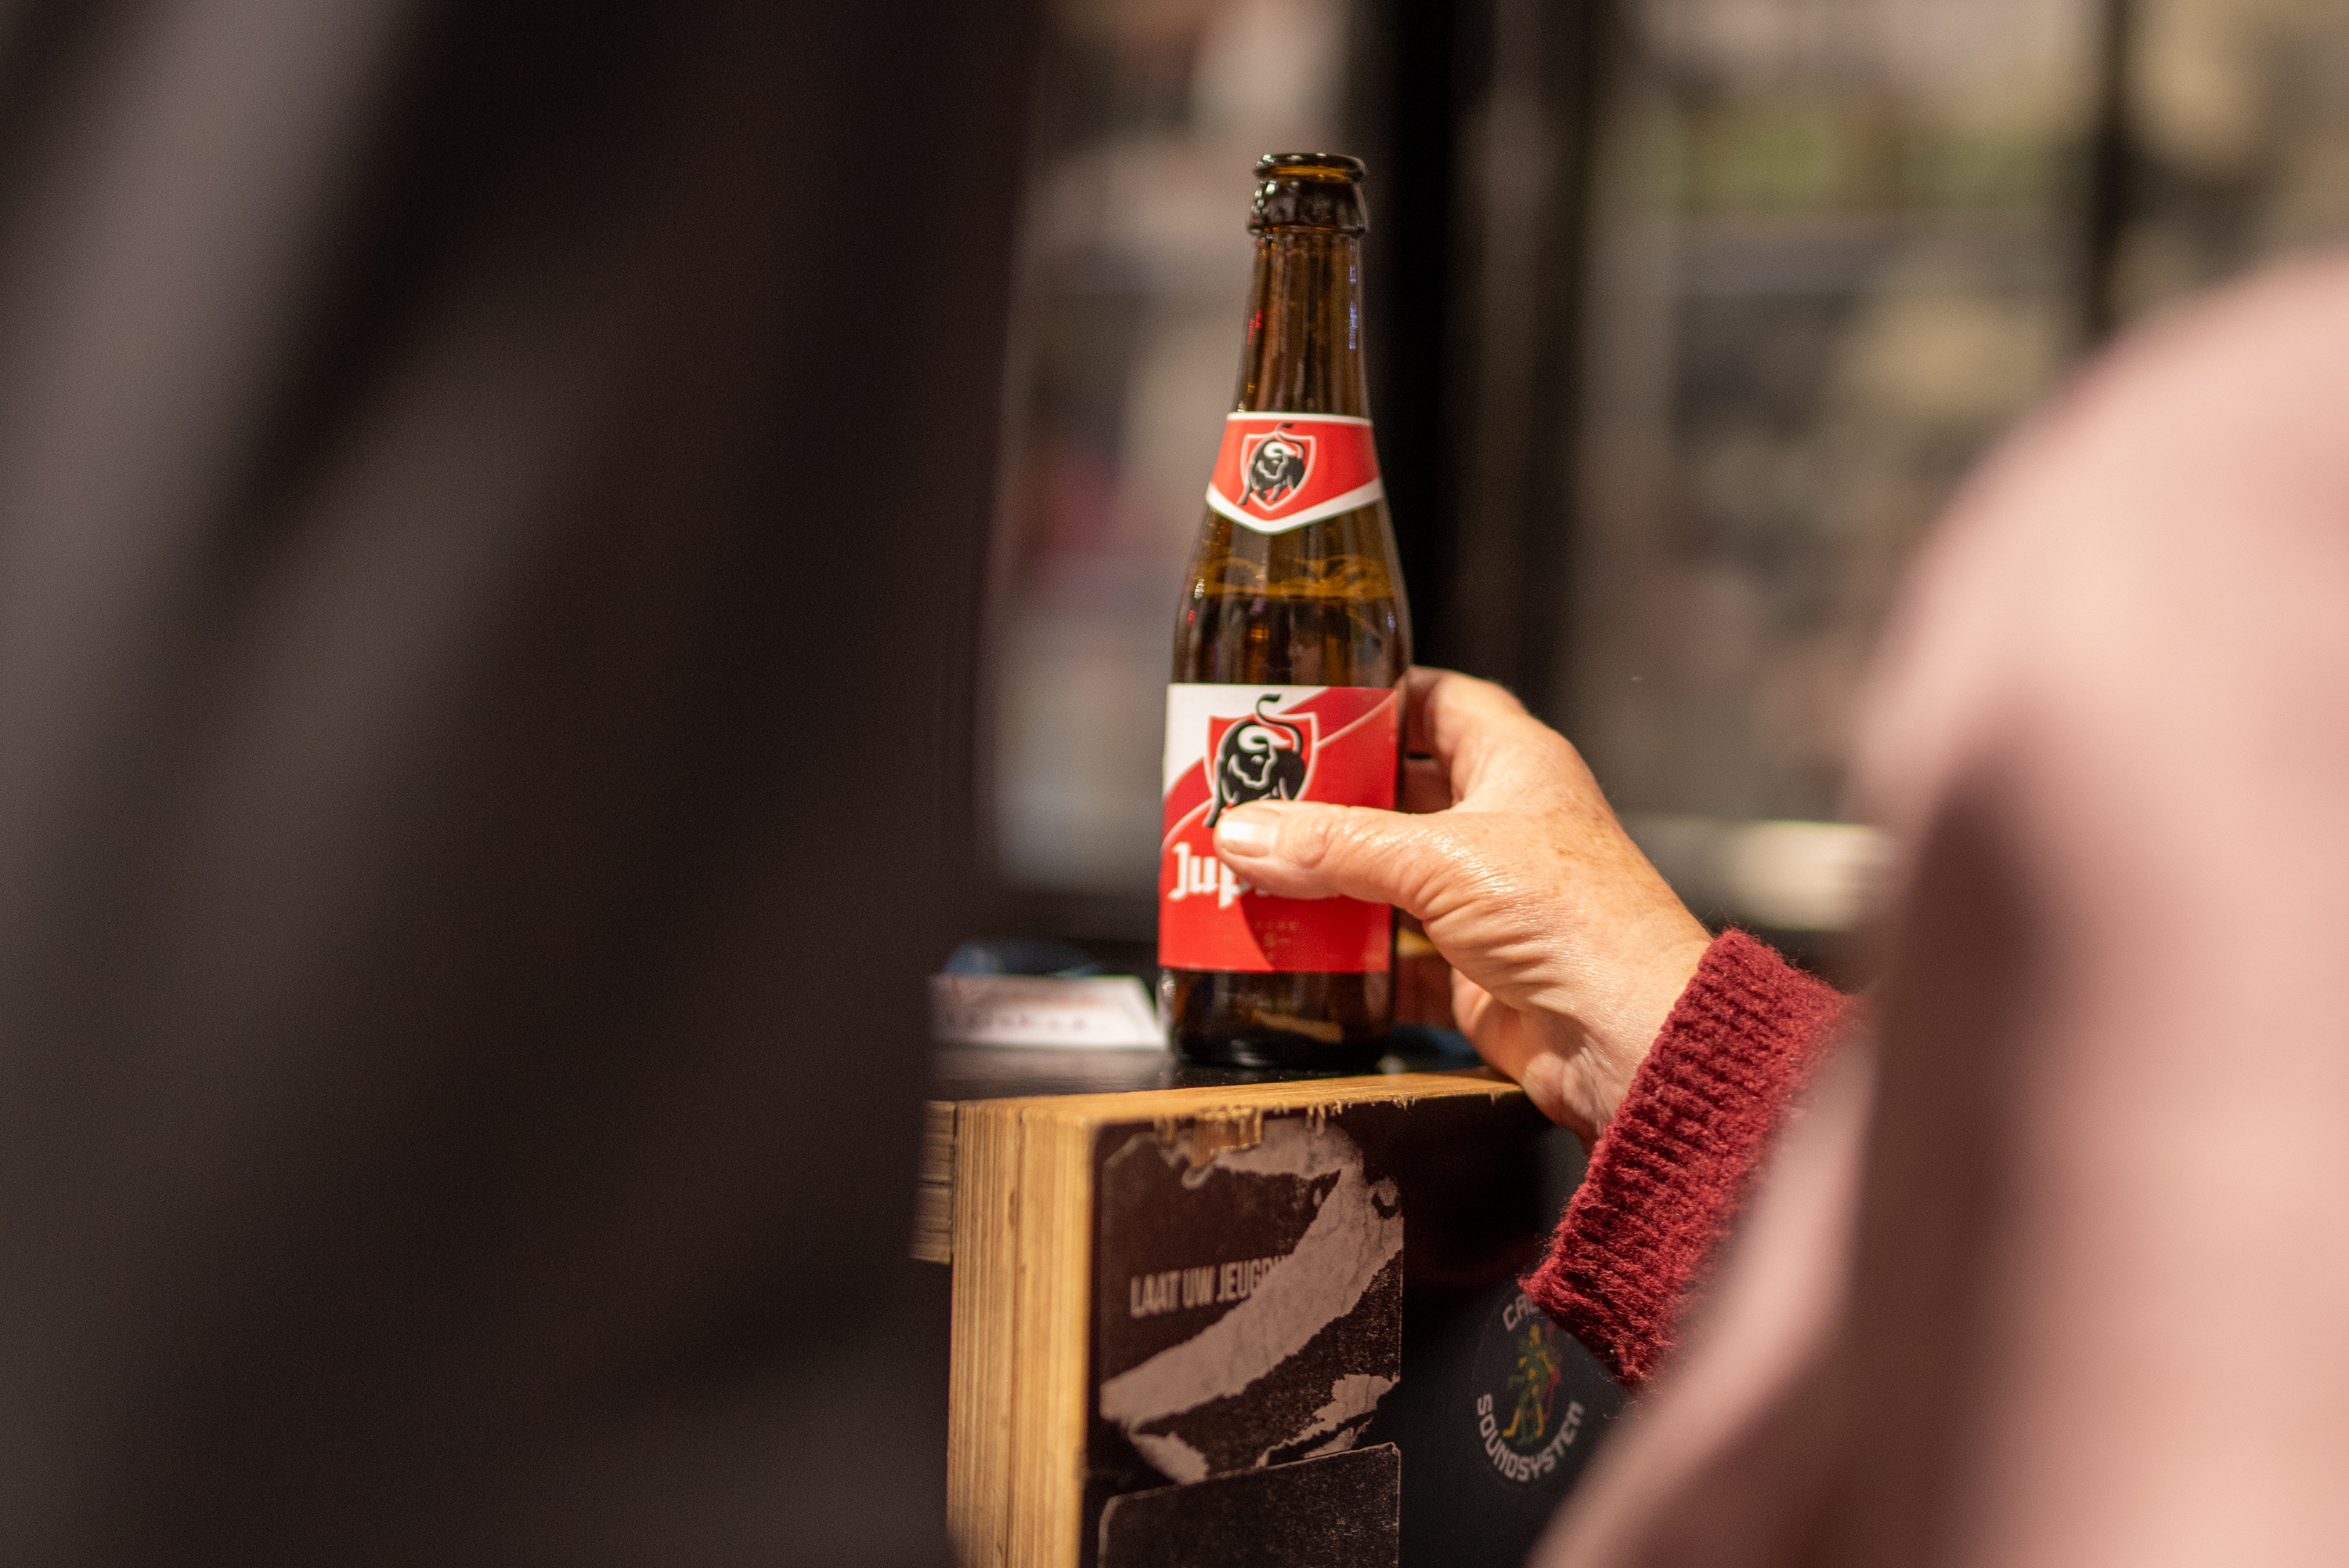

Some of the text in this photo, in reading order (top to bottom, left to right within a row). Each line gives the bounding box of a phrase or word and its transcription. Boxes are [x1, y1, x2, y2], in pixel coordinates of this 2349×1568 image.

[1168, 842, 1268, 909] Jup
[1131, 1254, 1289, 1317] LAAT UW JEUG
[1478, 1393, 1584, 1482] SOUNDSYSTEM
